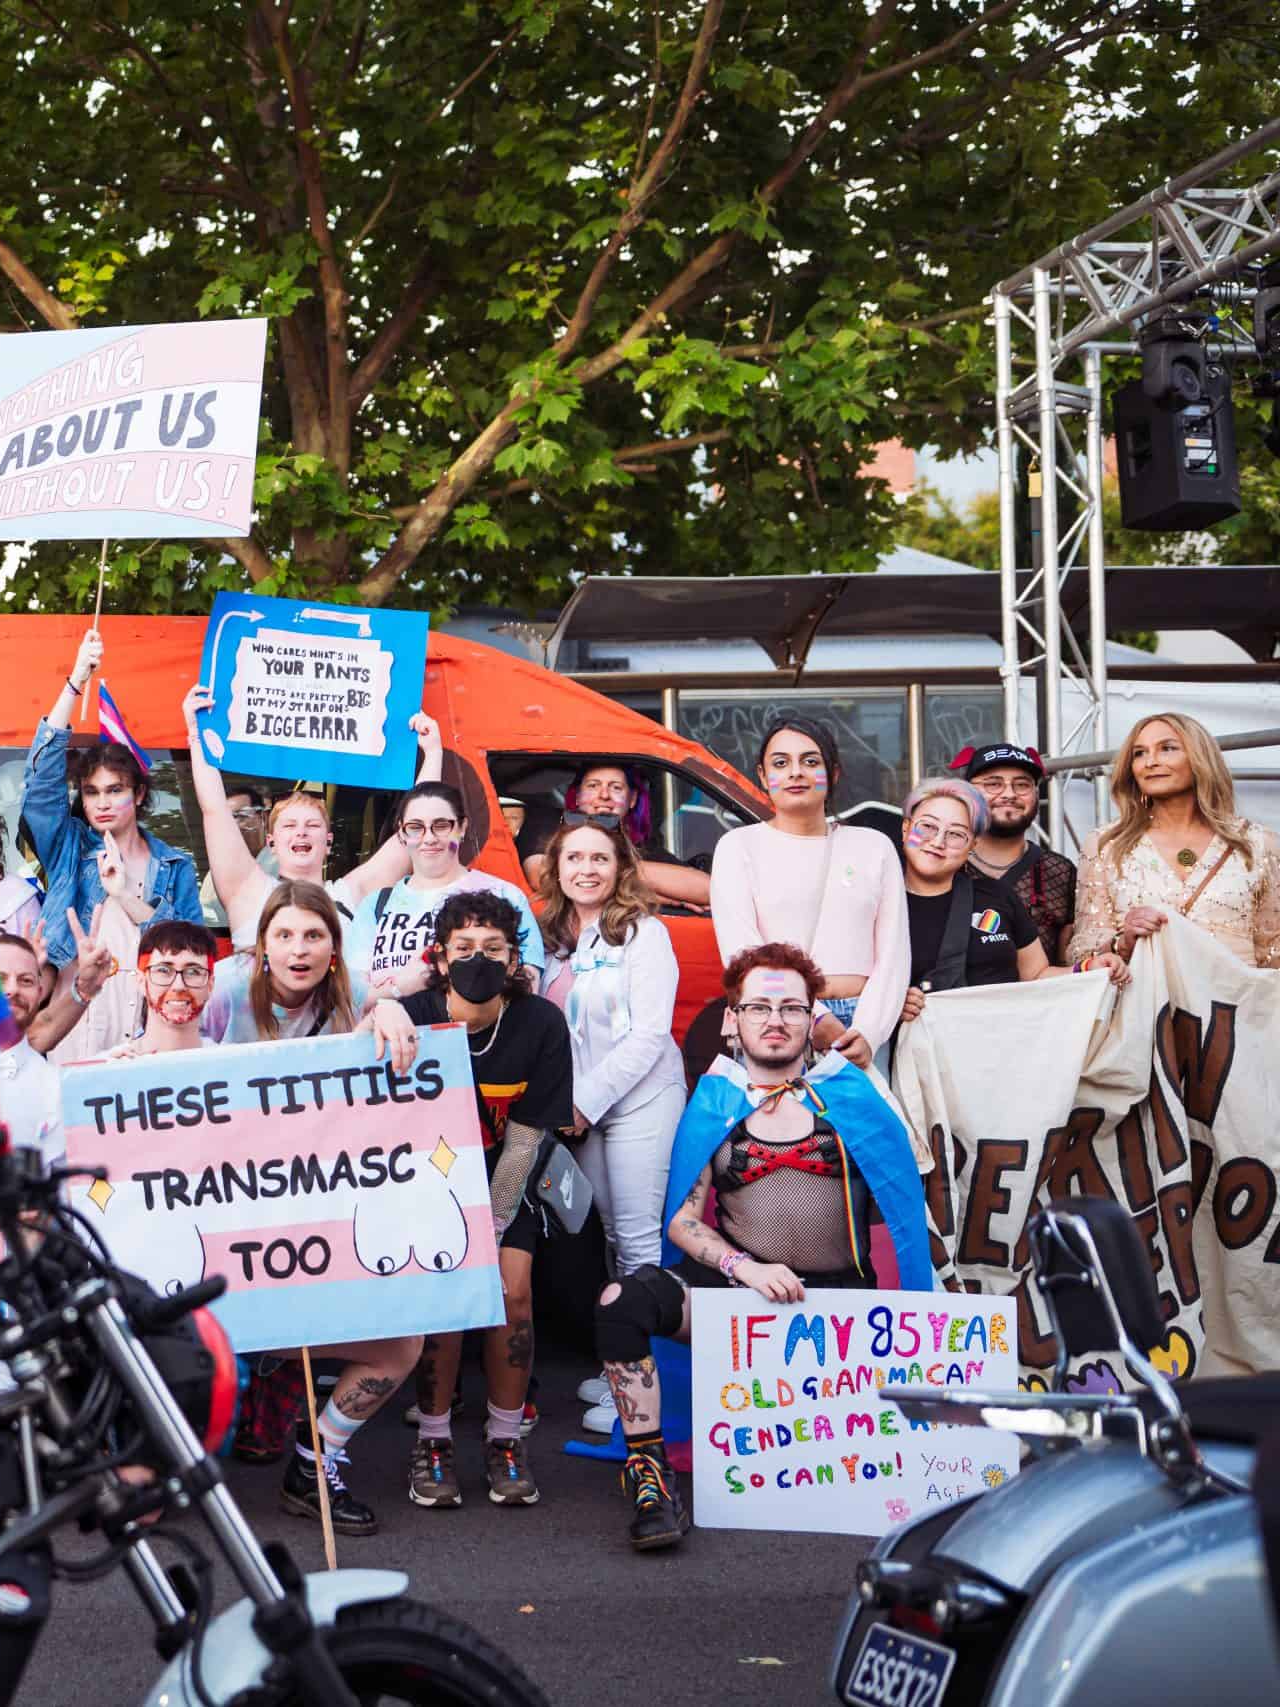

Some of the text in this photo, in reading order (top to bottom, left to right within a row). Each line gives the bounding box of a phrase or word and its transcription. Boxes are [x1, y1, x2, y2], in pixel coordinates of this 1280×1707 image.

[158, 390, 218, 449] US
[155, 459, 239, 518] US!
[252, 643, 359, 662] WHO CARES WHAT'S IN
[262, 658, 370, 683] YOUR PANTS
[247, 686, 261, 695] MY
[265, 687, 286, 697] TITS
[309, 692, 344, 703] PRETTY
[347, 689, 371, 708] BIG
[247, 698, 266, 706] BUT
[268, 699, 286, 709] MY
[245, 711, 358, 742] BIGGERRRR
[983, 748, 1034, 763] BEAR
[84, 1058, 444, 1135] THESE TITTIES
[132, 1143, 416, 1211] TRANSMASC
[230, 1235, 332, 1281] TOO
[731, 1306, 1009, 1372] IF MY 85 YEAR
[720, 1378, 794, 1412] OLD
[708, 1414, 834, 1456] GENDER
[846, 1411, 900, 1437] ME
[776, 1464, 834, 1489] CAN
[841, 1451, 903, 1484] YOU!
[921, 1453, 973, 1477] YOUR
